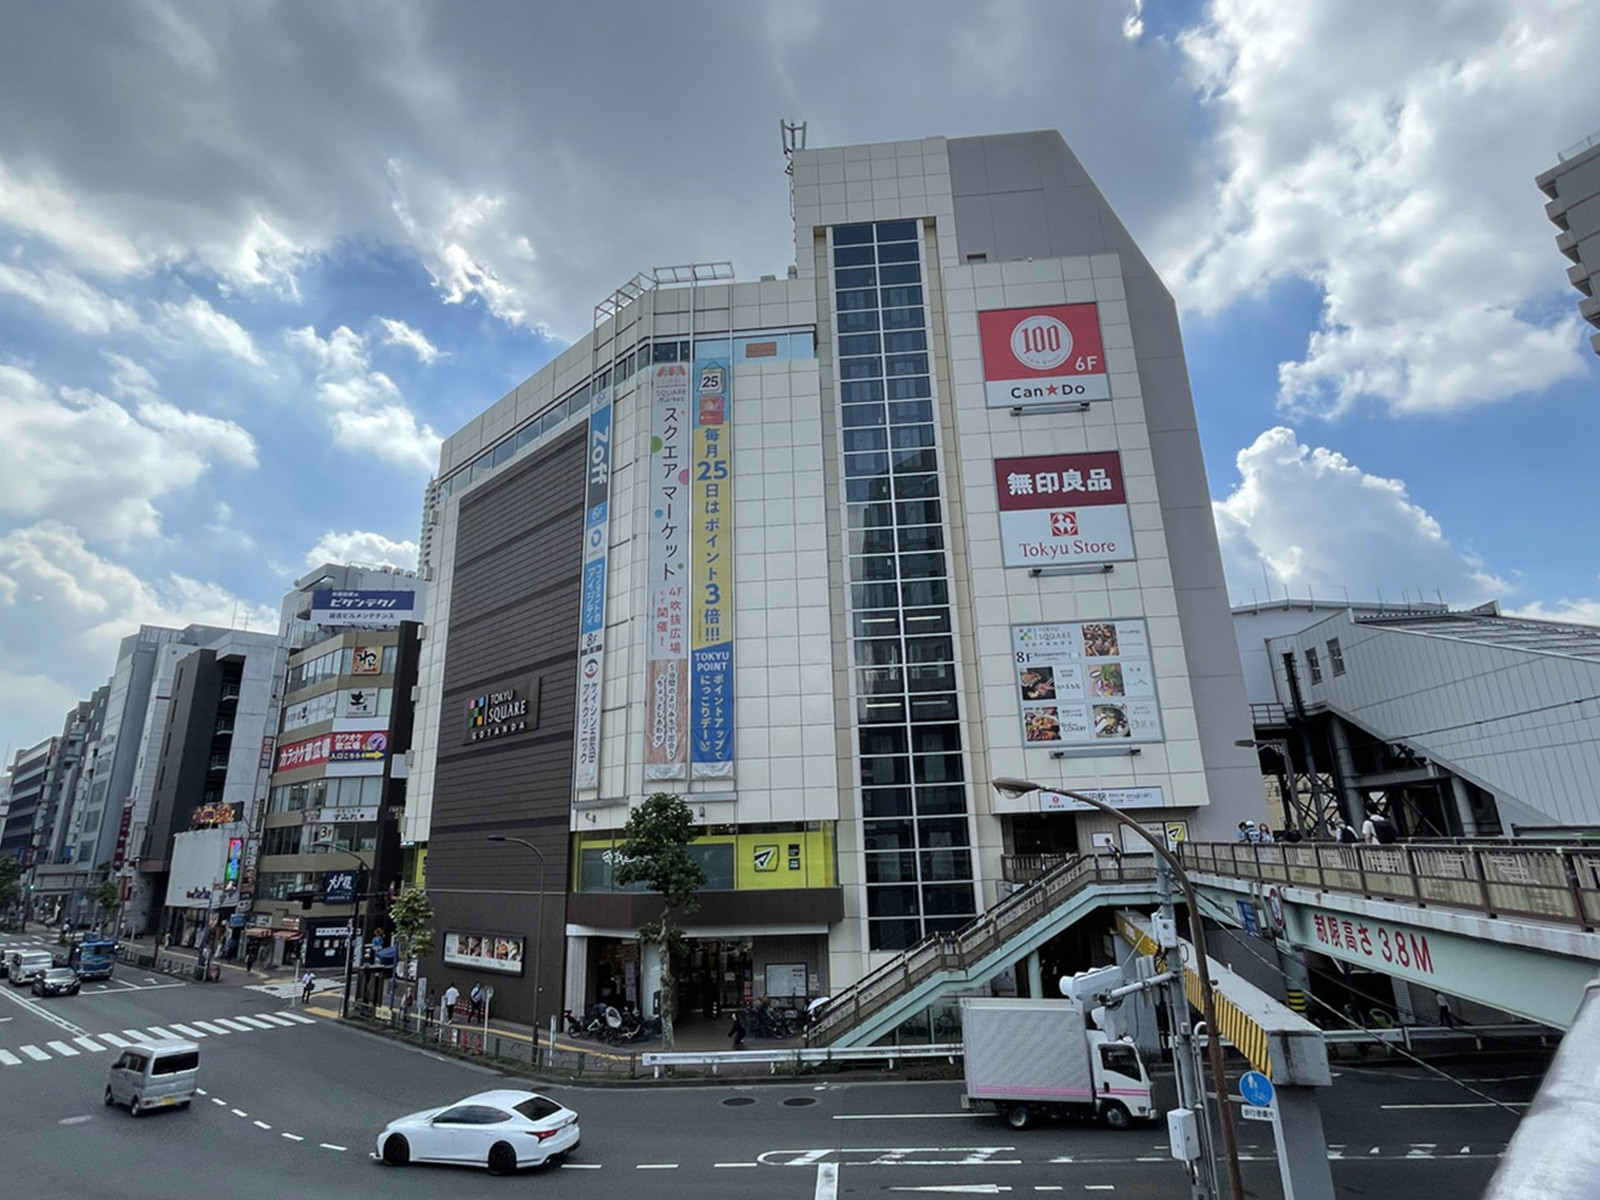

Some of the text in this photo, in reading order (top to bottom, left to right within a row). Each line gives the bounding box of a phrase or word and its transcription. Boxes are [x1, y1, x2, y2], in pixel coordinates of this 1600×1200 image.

[1021, 325, 1061, 354] 100
[1075, 356, 1097, 371] 6F
[702, 375, 719, 388] 25
[592, 425, 609, 484] Zoff
[1007, 468, 1112, 495] 無印良品
[1019, 540, 1116, 559] Tokyu Store
[587, 633, 598, 647] 8F
[694, 652, 729, 661] TOKYU
[697, 662, 727, 671] POINT
[490, 689, 514, 704] TOKYU
[488, 700, 526, 722] SQUARE
[472, 721, 525, 740] GOTANDA
[1313, 913, 1434, 974] 制限高さ 3.8M
